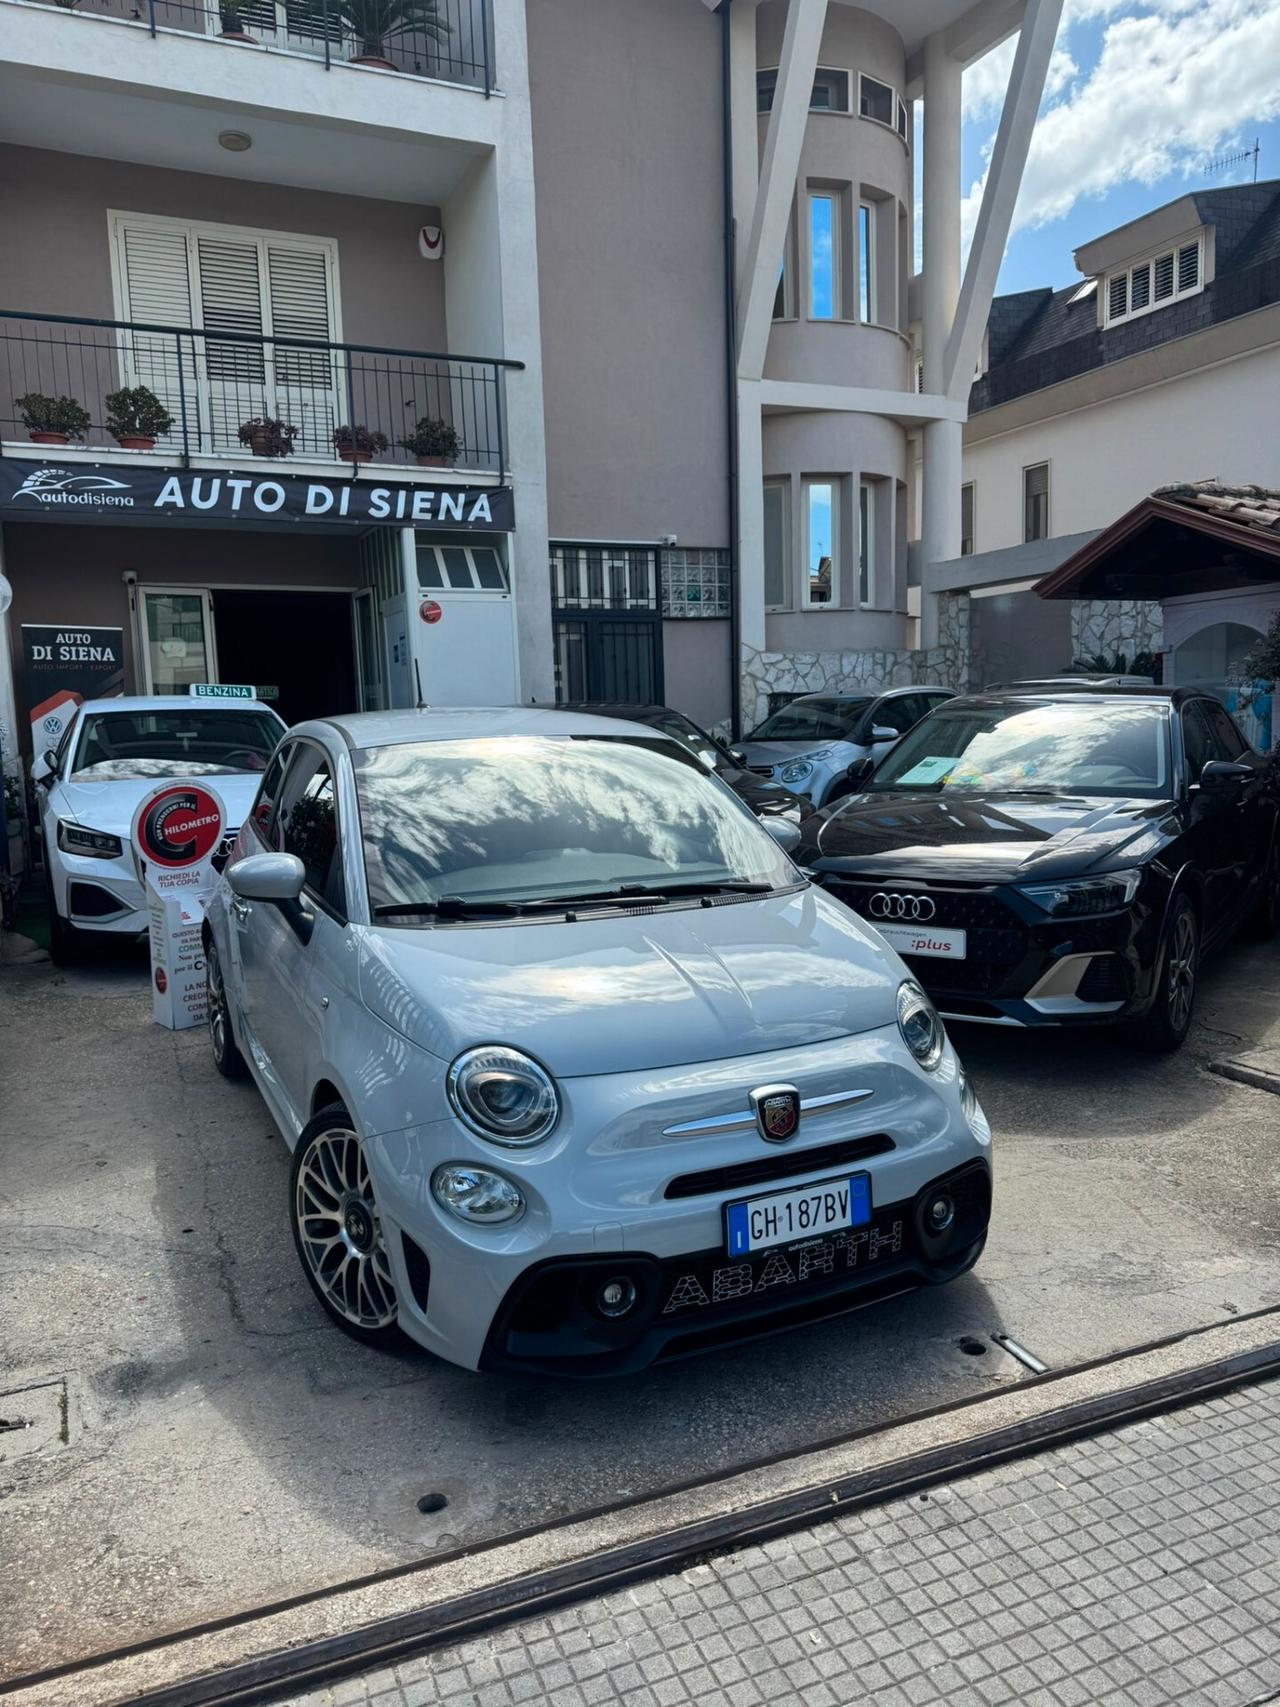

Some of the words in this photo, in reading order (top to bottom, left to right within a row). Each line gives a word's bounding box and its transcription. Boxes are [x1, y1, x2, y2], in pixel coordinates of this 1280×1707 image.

[41, 490, 135, 507] autodisiena
[154, 476, 287, 513] AUTO
[305, 485, 349, 516] DI
[368, 488, 494, 523] SIENA
[56, 633, 91, 644] AUTO
[32, 646, 53, 660] DI
[60, 646, 115, 662] SIENA
[198, 686, 249, 697] BENZINA
[158, 872, 190, 882] RICHIEDI
[191, 870, 201, 878] LA
[176, 877, 199, 886] COPIA
[184, 982, 195, 991] LA
[751, 1189, 849, 1240] GH187BV
[663, 1220, 902, 1314] ABARTH
